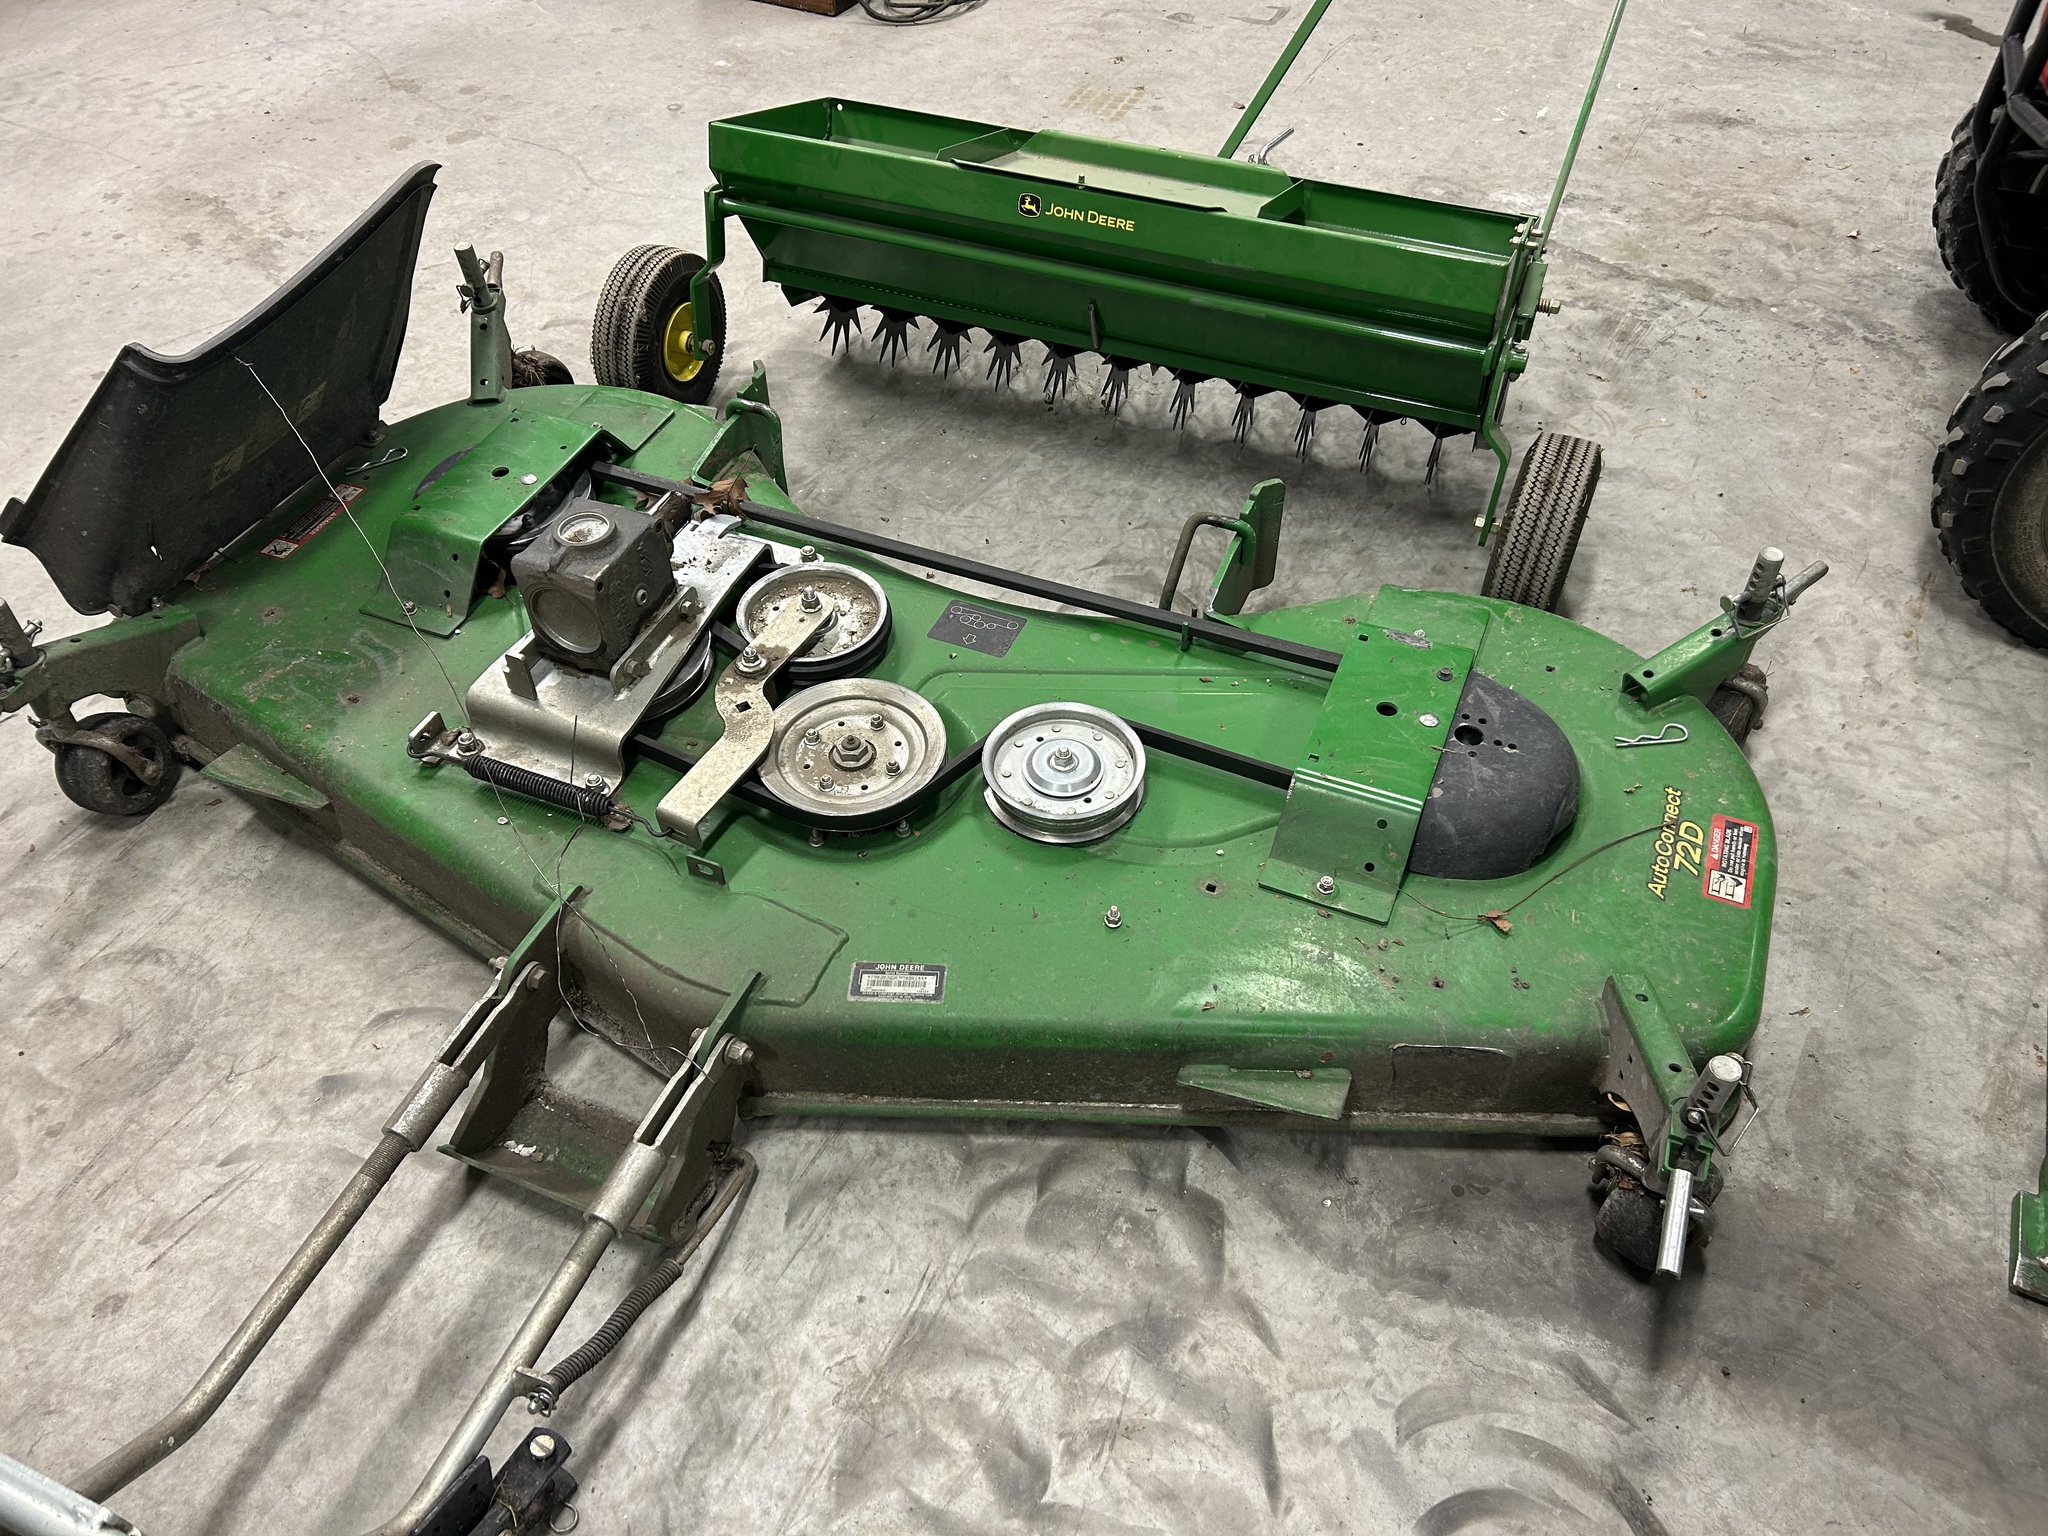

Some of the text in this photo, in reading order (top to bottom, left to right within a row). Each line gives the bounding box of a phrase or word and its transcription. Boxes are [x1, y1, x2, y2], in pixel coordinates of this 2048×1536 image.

[1045, 203, 1136, 232] JOHN DEERE
[1647, 786, 1682, 899] AutoConnect
[1673, 820, 1705, 877] 72D
[1711, 828, 1721, 852] DANGER
[875, 963, 897, 971] JOHN
